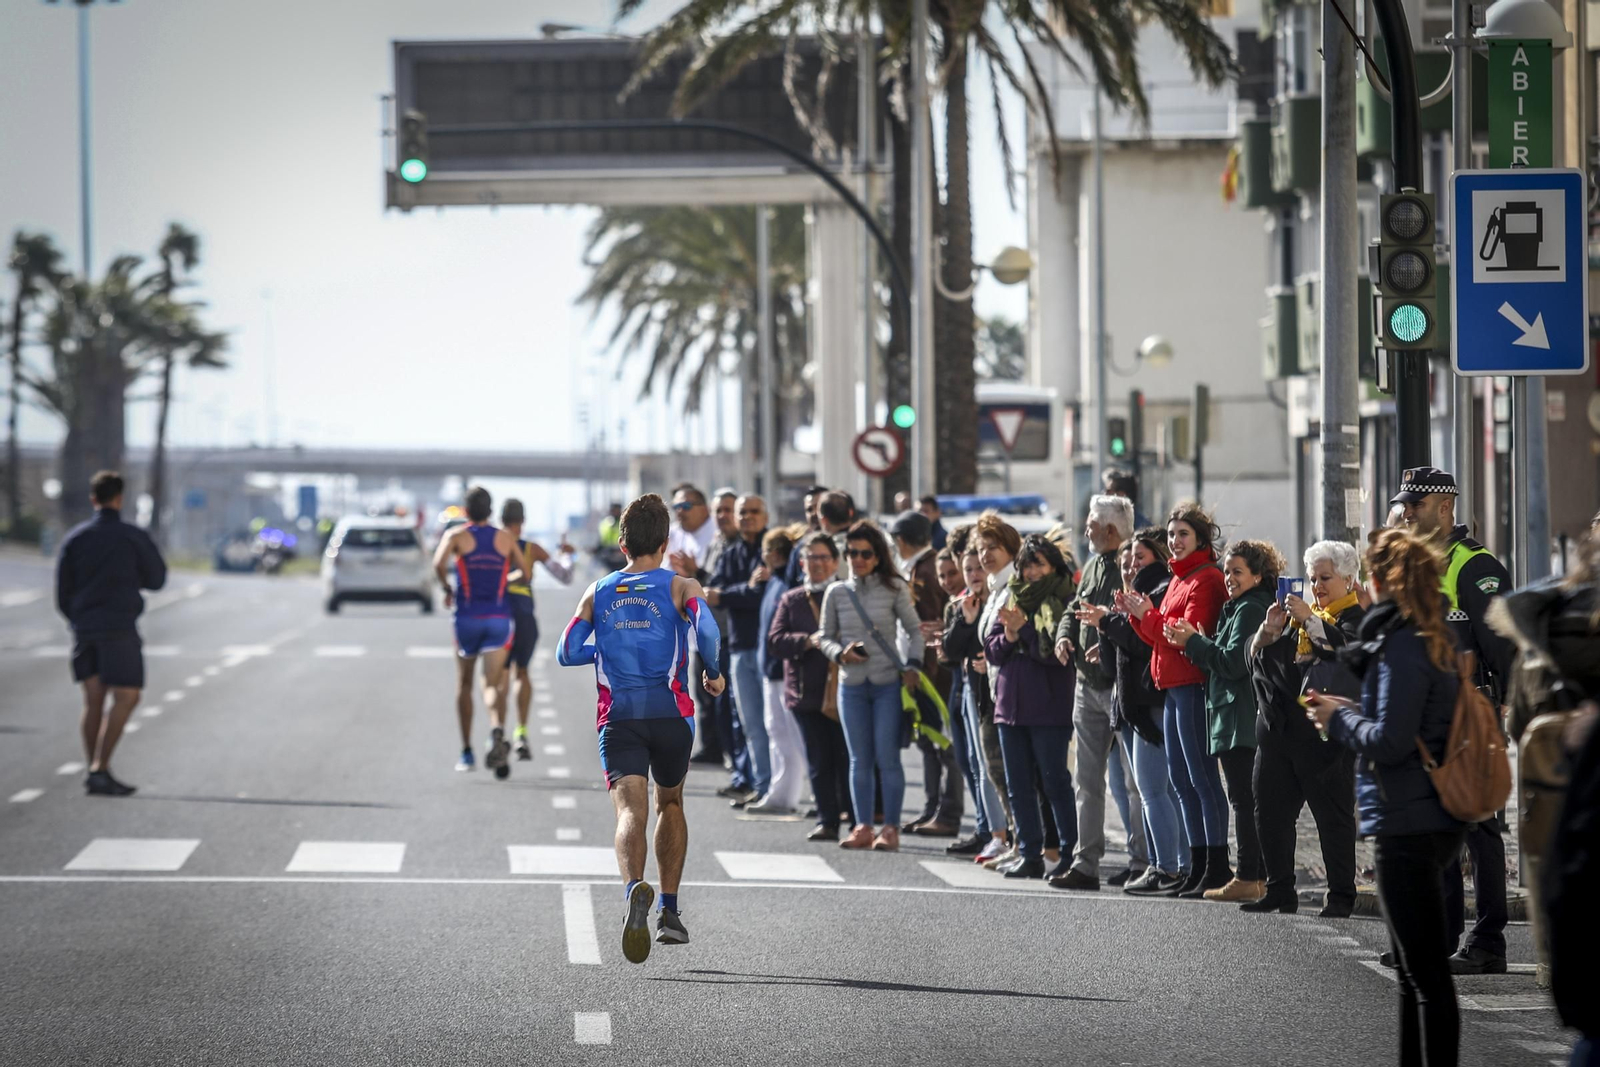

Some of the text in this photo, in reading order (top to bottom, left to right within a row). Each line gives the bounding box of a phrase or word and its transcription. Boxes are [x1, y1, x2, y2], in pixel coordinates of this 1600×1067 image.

[611, 596, 648, 611] Carmona
[614, 619, 651, 630] San Fernando
